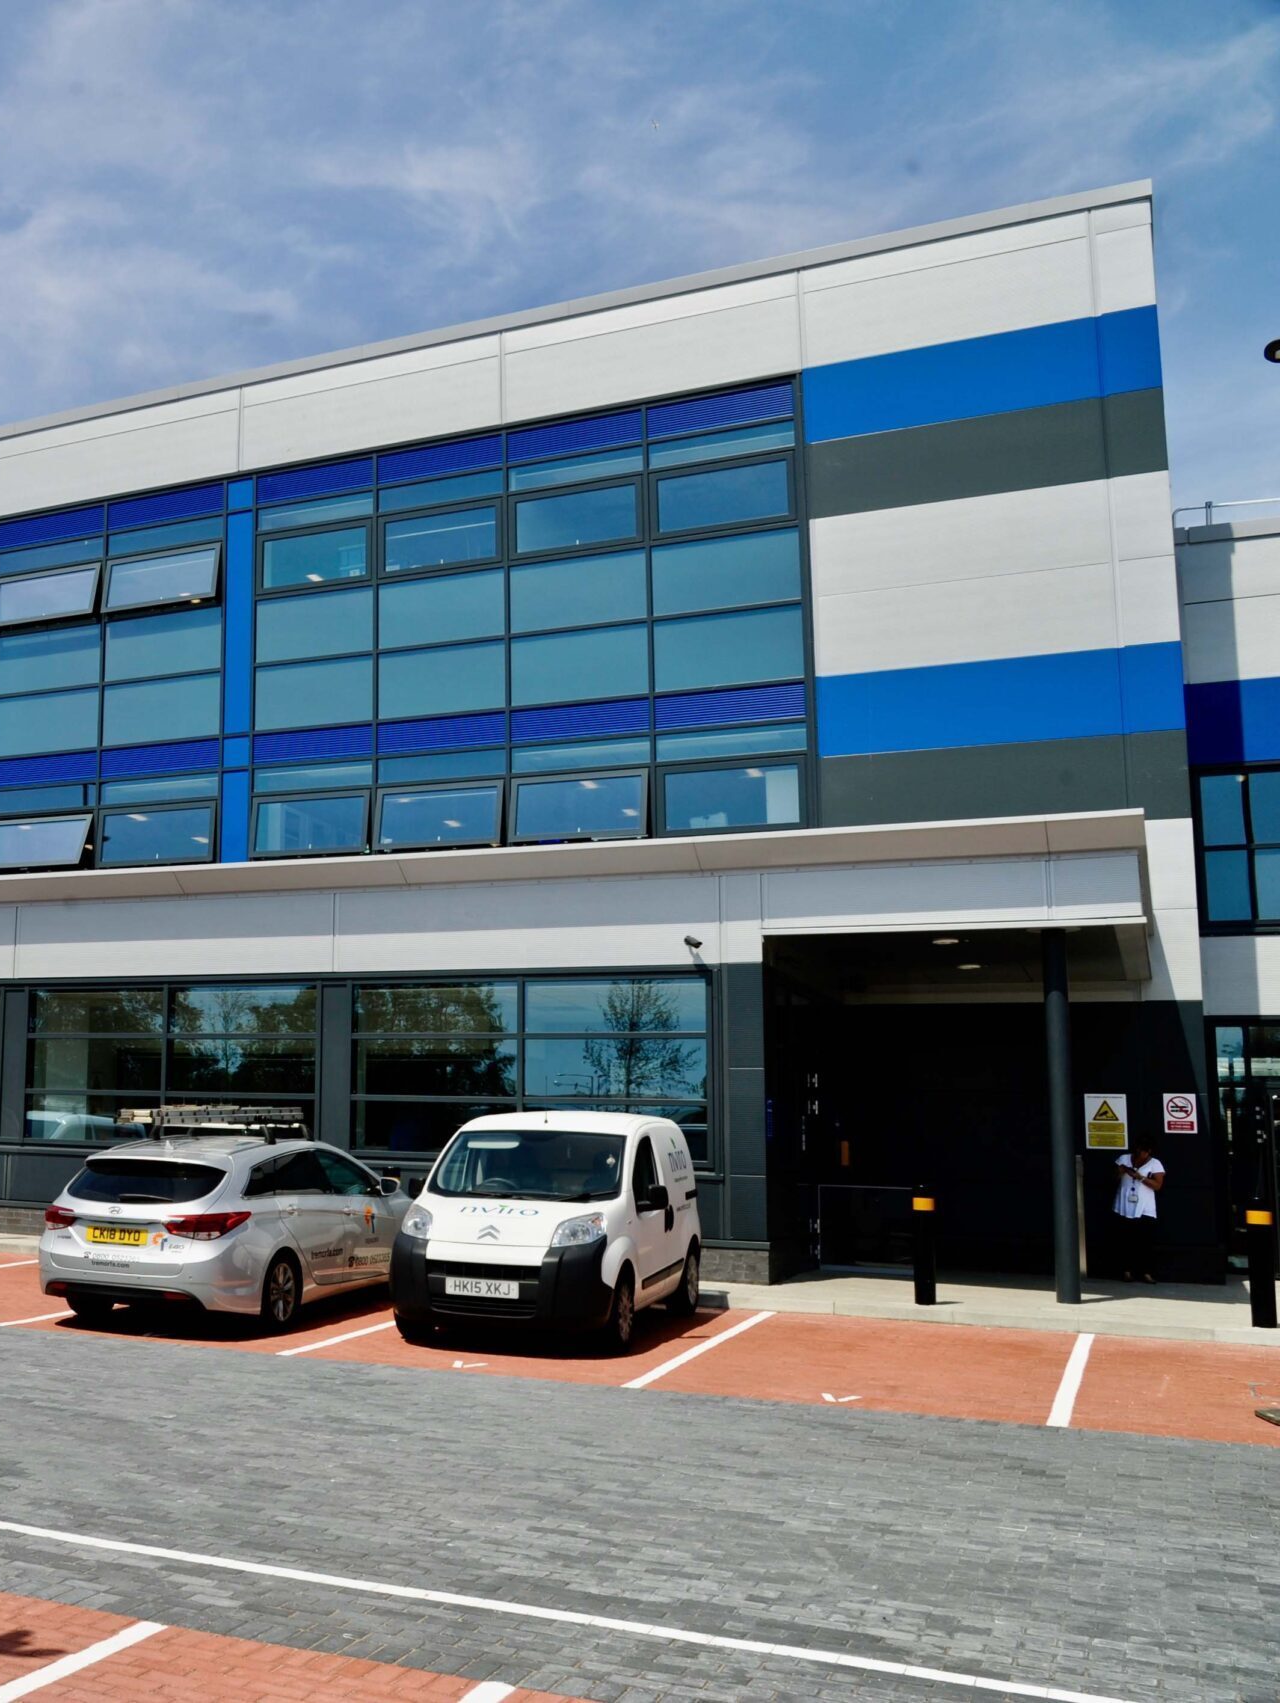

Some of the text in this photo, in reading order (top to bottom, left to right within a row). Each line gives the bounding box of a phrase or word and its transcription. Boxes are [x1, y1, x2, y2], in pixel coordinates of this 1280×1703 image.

[460, 1204, 539, 1216] nviro
[92, 1226, 115, 1240] CK18
[453, 1279, 511, 1296] HK15 XKJ
